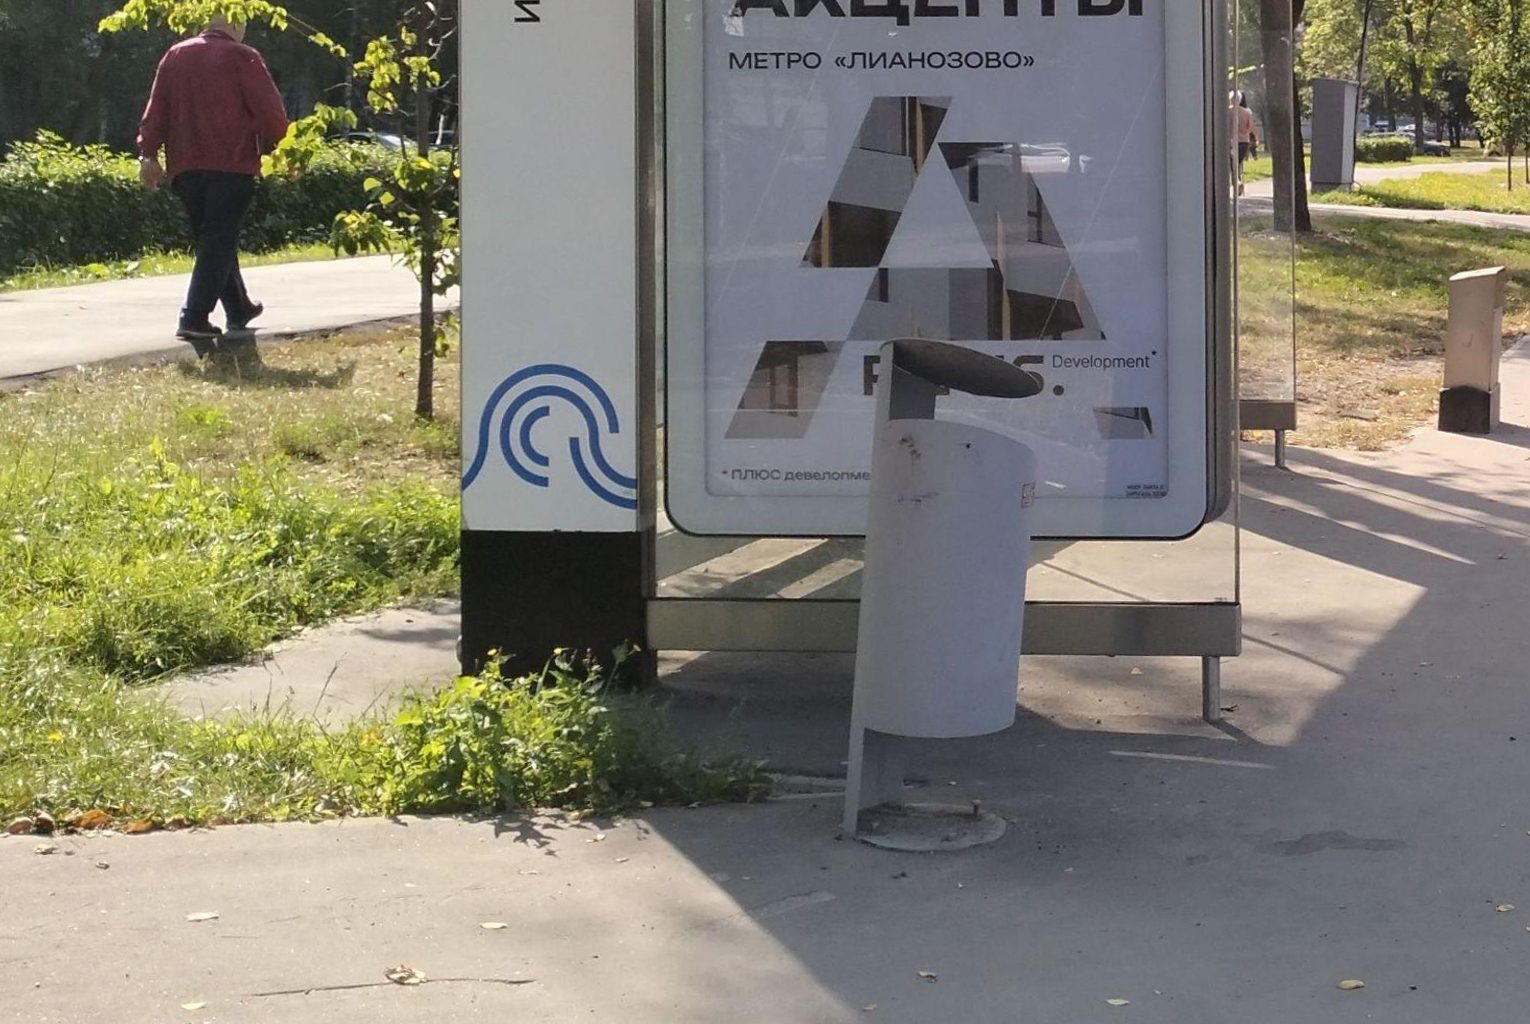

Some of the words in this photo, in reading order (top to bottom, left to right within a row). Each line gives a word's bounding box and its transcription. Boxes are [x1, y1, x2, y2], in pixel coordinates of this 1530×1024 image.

[728, 51, 822, 70] МЕТРО
[833, 50, 1036, 70] «ЛИАНОЗОВО»
[784, 470, 872, 481] девелопме
